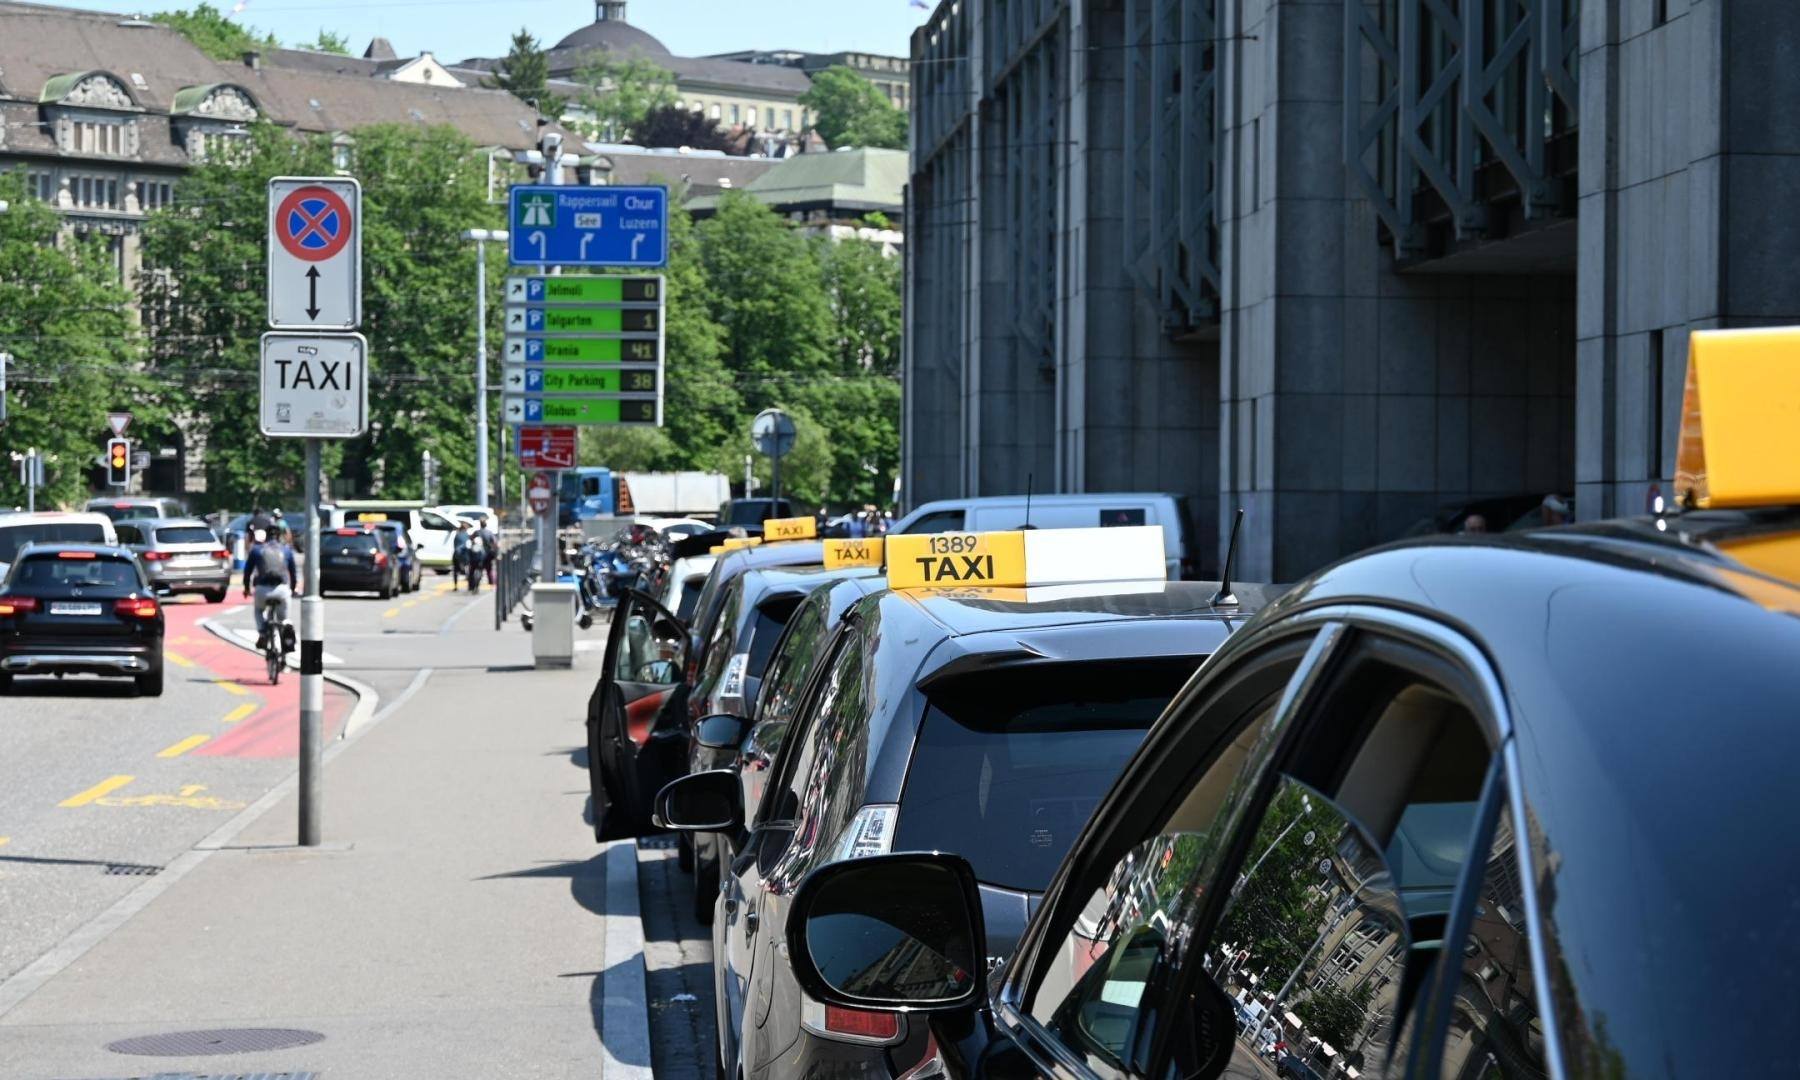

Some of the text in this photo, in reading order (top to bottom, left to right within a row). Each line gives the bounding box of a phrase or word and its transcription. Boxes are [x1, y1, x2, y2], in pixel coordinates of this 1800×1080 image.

[559, 194, 617, 210] Rapperswil
[624, 196, 654, 210] Chur
[577, 214, 598, 226] See
[619, 216, 658, 229] Luzern
[643, 283, 655, 299] 0
[643, 313, 655, 329] 1
[546, 343, 580, 356] Urania
[632, 342, 653, 359] 41
[274, 360, 351, 391] TAXI
[545, 373, 563, 389] City
[568, 374, 605, 389] Parking
[632, 373, 653, 389] 38
[544, 403, 577, 416] Globus
[776, 526, 803, 536] TAXI
[929, 535, 977, 554] 1389
[834, 548, 870, 560] TAXI
[916, 555, 994, 581] TAXI
